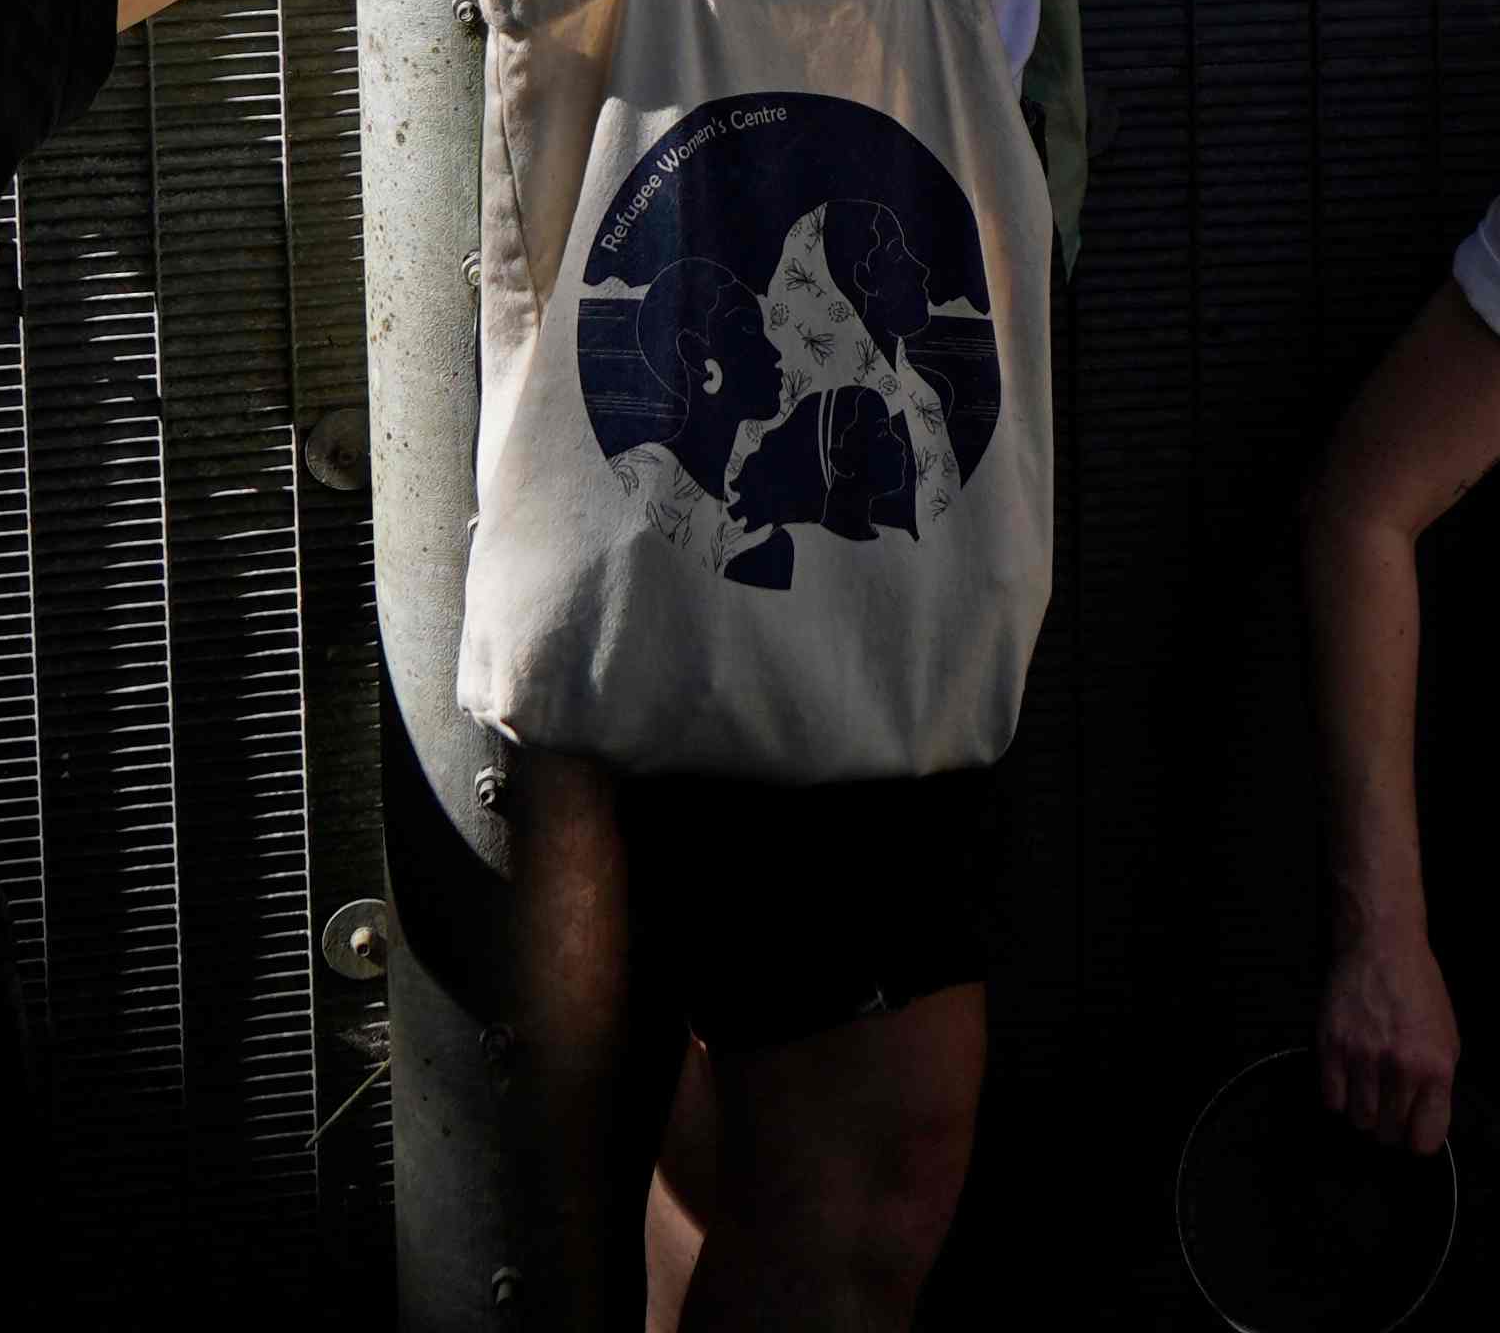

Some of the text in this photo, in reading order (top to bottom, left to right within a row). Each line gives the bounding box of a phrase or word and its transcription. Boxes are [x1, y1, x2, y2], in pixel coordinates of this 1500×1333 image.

[601, 106, 788, 252] Refugee Women's Centre
